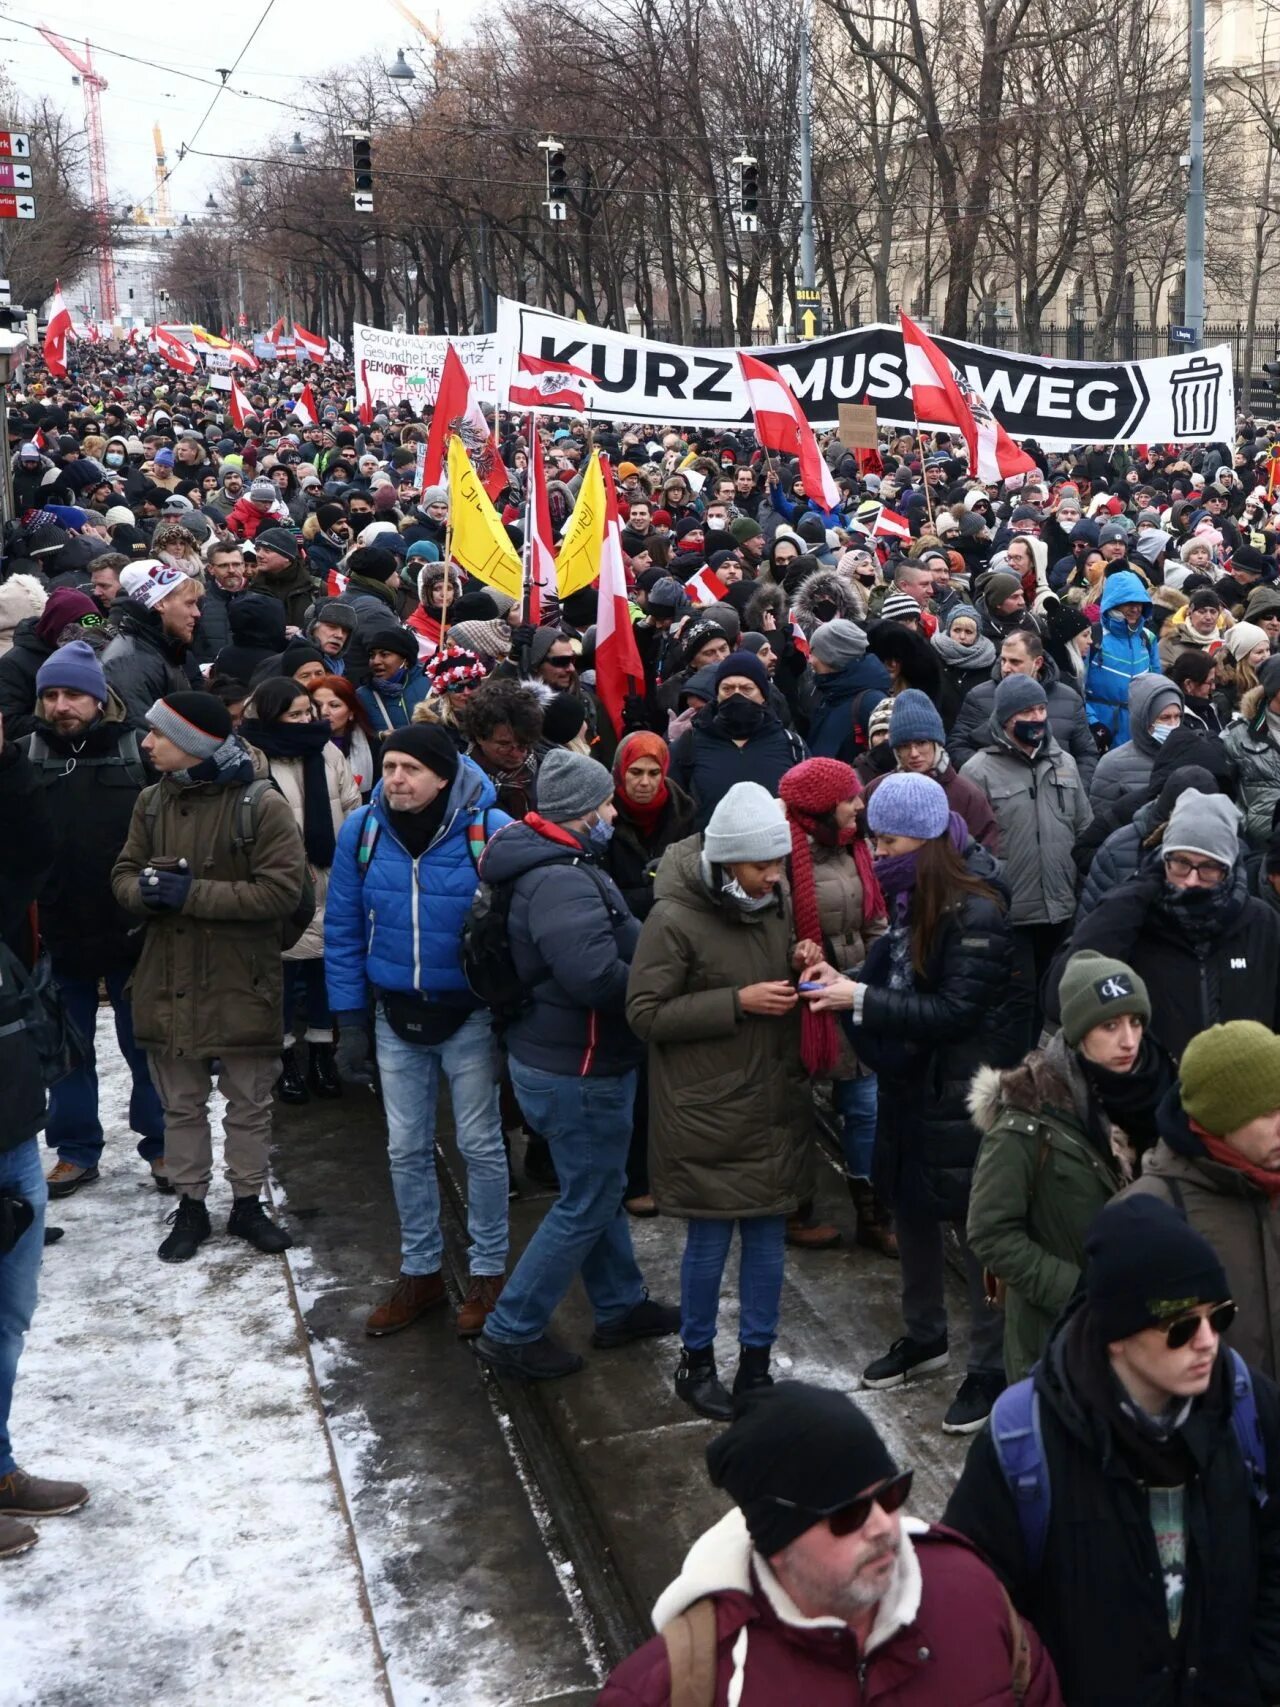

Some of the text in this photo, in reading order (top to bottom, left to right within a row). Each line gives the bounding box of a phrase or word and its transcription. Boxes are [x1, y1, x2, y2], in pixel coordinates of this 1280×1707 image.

[796, 290, 821, 300] BILLA
[541, 336, 1119, 421] KURZ MUS WEG
